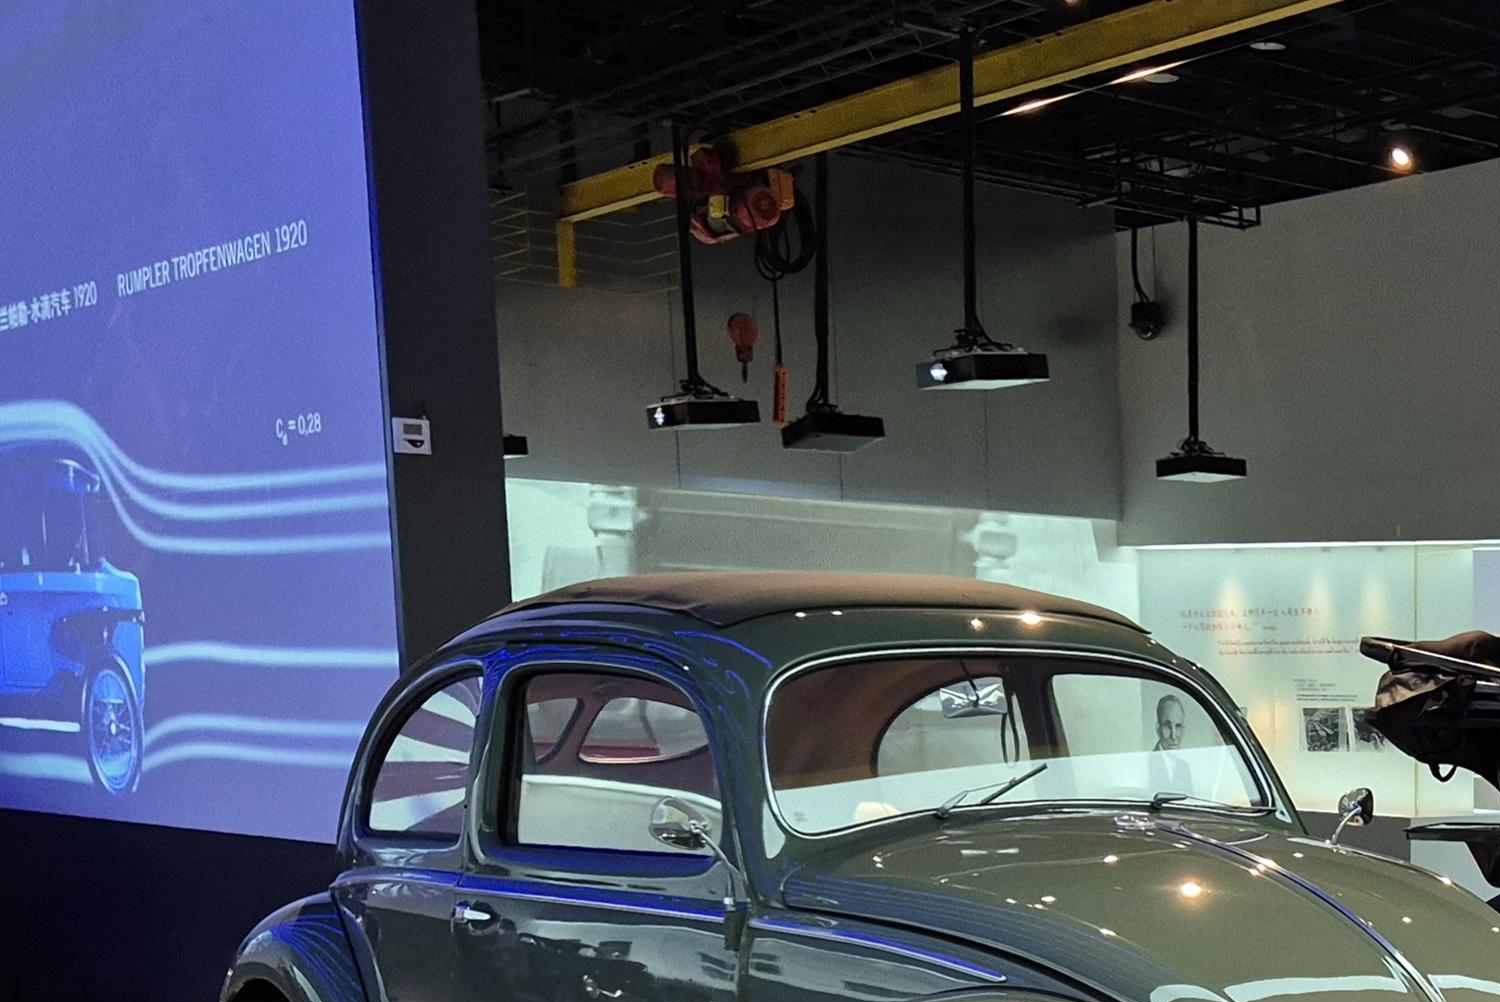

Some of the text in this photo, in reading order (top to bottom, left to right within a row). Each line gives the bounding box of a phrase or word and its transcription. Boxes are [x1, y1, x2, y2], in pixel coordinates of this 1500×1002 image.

[117, 219, 308, 297] RUMPLER TROPFENWAGEN 1920
[73, 280, 98, 308] 1920
